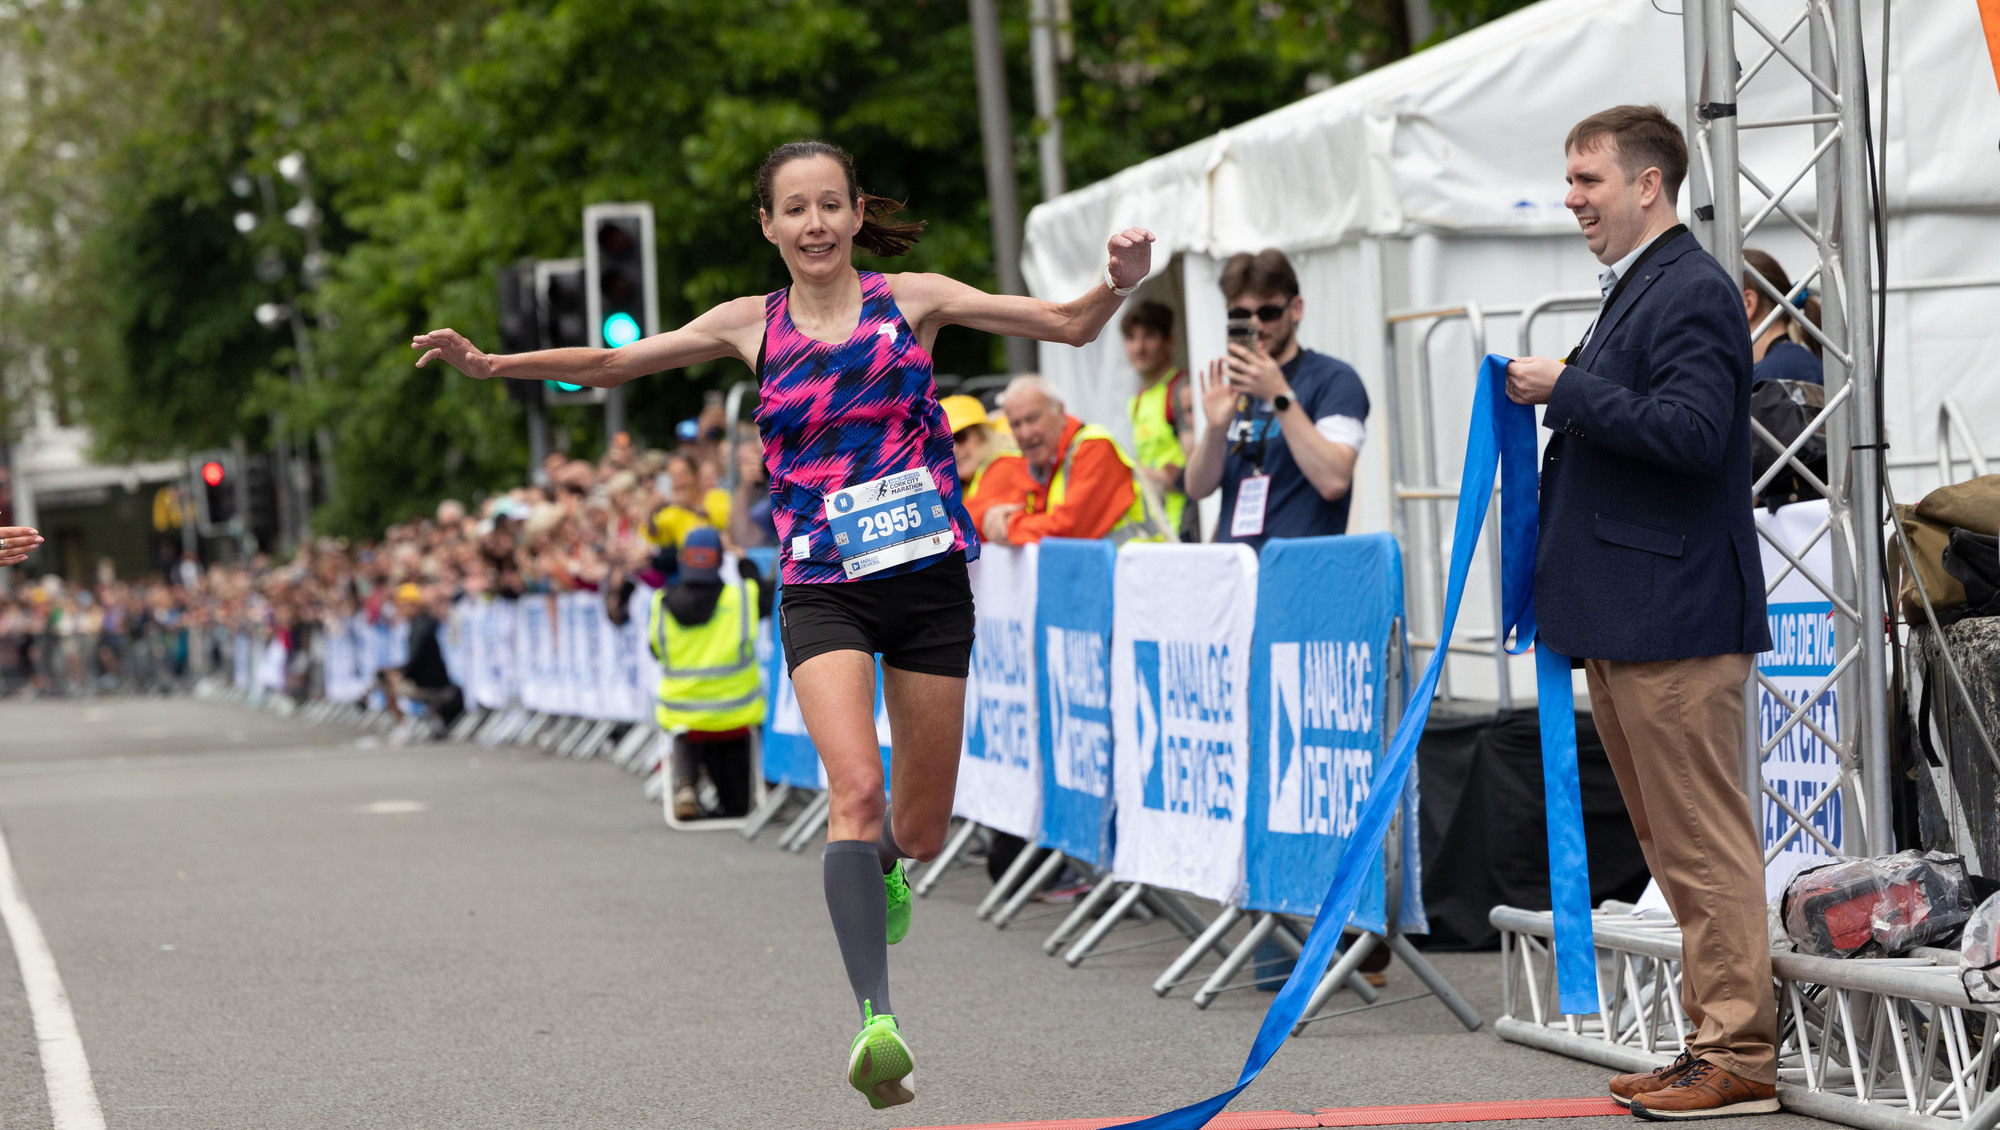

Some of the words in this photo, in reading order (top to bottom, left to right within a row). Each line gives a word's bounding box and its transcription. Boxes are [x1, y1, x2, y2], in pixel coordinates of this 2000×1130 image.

[840, 497, 848, 508] M
[889, 480, 906, 490] CORK
[906, 477, 919, 485] CITY
[891, 482, 923, 495] MARATHON
[857, 502, 922, 543] 2955
[1757, 613, 1796, 667] ALOG
[1797, 613, 1837, 666] DEVIC
[1166, 641, 1233, 723] ANALOG
[1303, 640, 1373, 735] ANALOG
[1167, 734, 1235, 823] DEVICES
